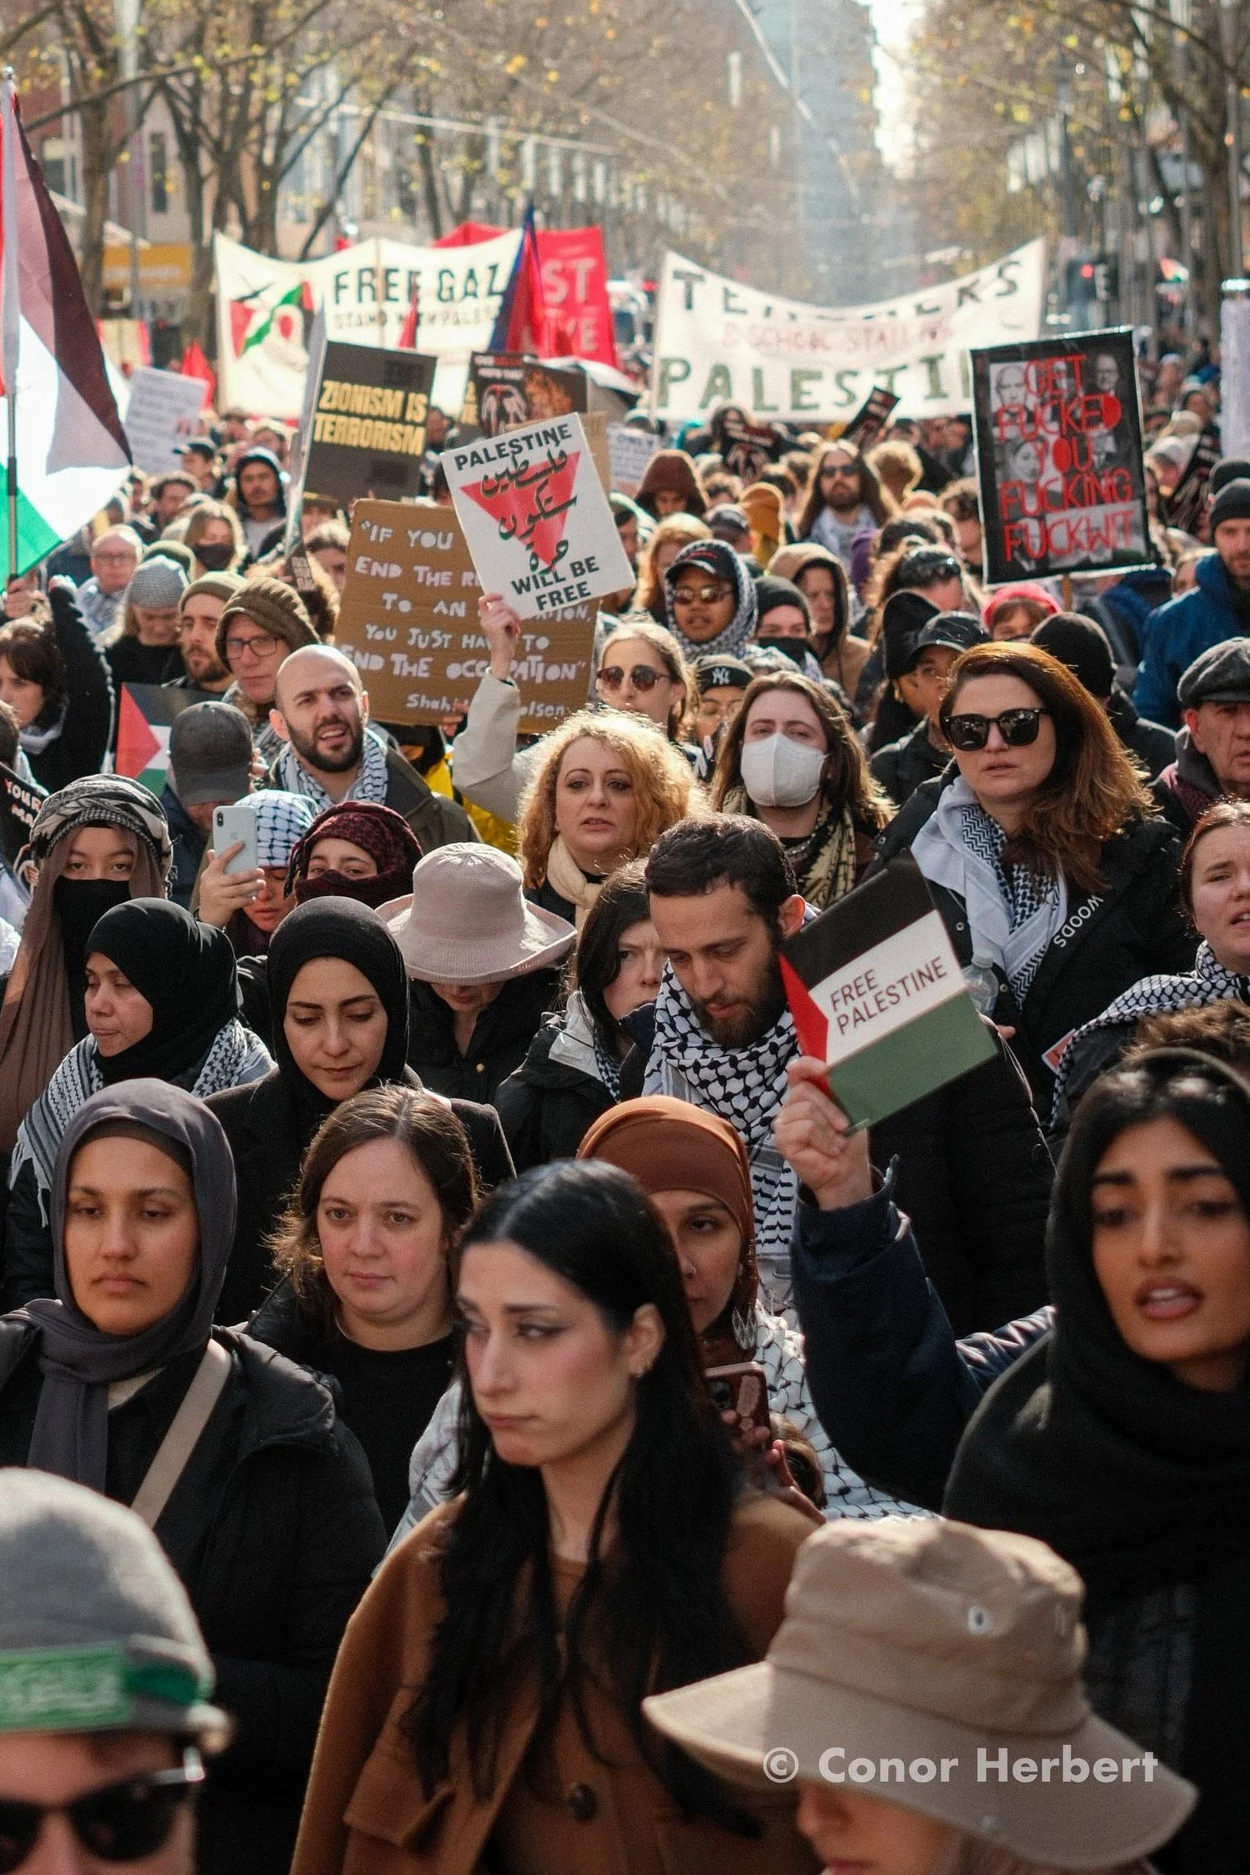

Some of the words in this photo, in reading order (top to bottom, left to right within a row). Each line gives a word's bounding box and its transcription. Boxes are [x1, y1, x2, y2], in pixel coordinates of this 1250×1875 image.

[437, 261, 505, 303] GAZ
[659, 348, 971, 412] PALESTI
[1023, 353, 1087, 398] GET
[318, 380, 405, 419] ZIONISM
[405, 392, 429, 423] IS
[996, 392, 1122, 443] FUCKED
[313, 411, 426, 456] TERRORISM
[454, 423, 573, 472] PALESTINE
[1032, 434, 1095, 480] YOU
[1000, 466, 1135, 521] FUCKING
[407, 529, 455, 551] YOU
[1002, 508, 1136, 562] FUCKWIT
[354, 556, 403, 579] END
[413, 565, 453, 588] THE
[510, 568, 567, 596] WILL
[569, 555, 600, 579] BE
[382, 592, 413, 614] TO
[432, 599, 467, 618] AN
[535, 580, 592, 612] FREE
[365, 624, 398, 642] YOU
[407, 627, 452, 650] JUST
[521, 633, 550, 651] TO
[341, 644, 385, 671] END
[390, 653, 434, 678] THE
[518, 700, 566, 718] olsen
[4, 777, 42, 814] YOUR
[1053, 895, 1105, 948] WOODS
[829, 968, 879, 1013] FREE
[835, 956, 948, 1036] PALESTINE
